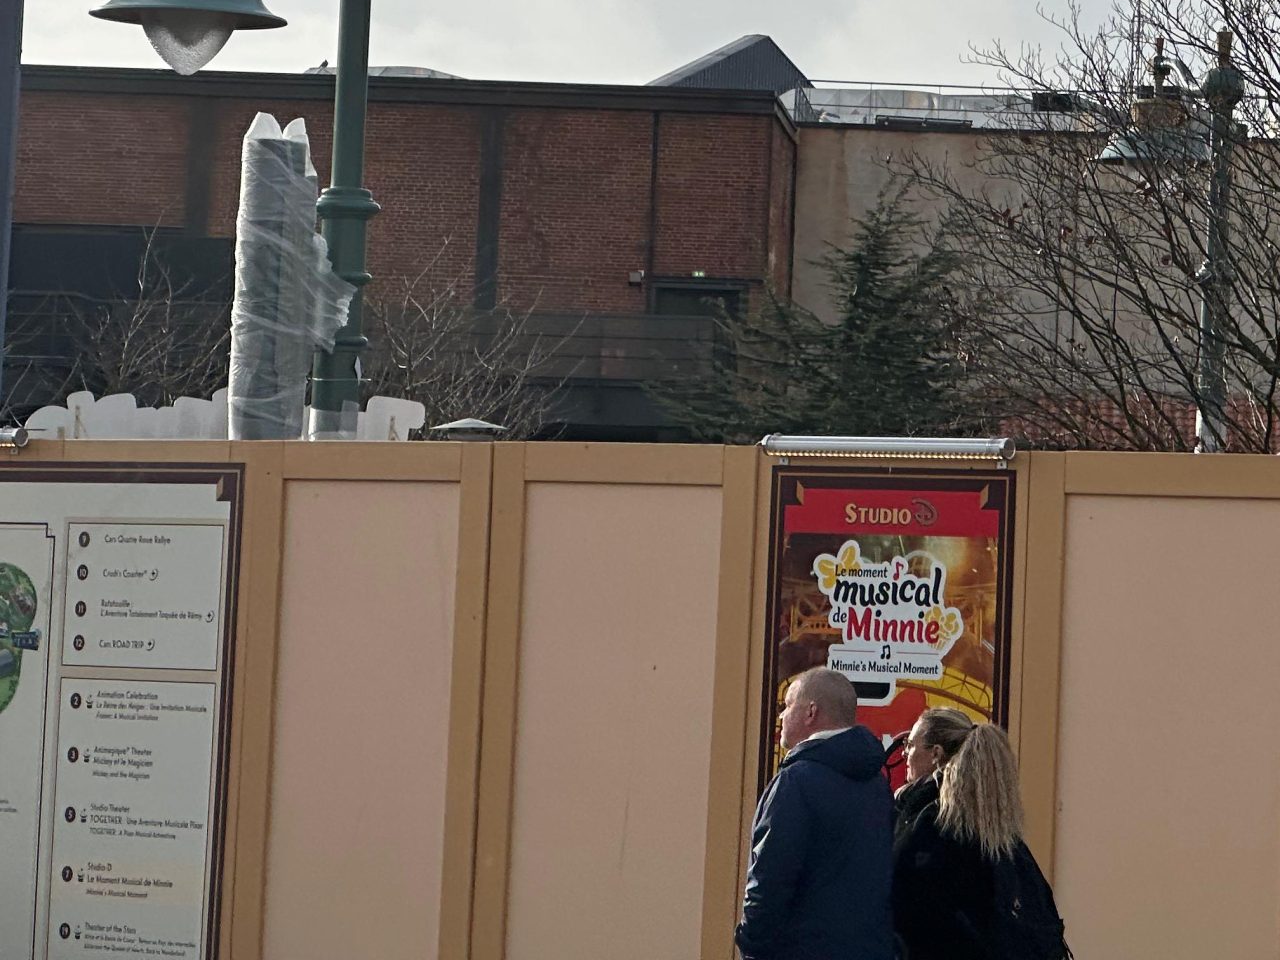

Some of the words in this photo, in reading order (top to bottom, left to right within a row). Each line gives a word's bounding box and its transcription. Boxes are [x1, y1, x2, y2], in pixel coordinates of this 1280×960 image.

[845, 503, 911, 525] STUDIO
[835, 565, 848, 578] Le
[849, 567, 888, 579] moment
[833, 567, 942, 607] musical
[832, 607, 847, 623] de
[846, 606, 940, 644] Minnie
[112, 640, 131, 649] ROAD
[831, 659, 867, 671] Minnie's
[868, 661, 902, 673] Musical
[903, 663, 939, 675] Moment
